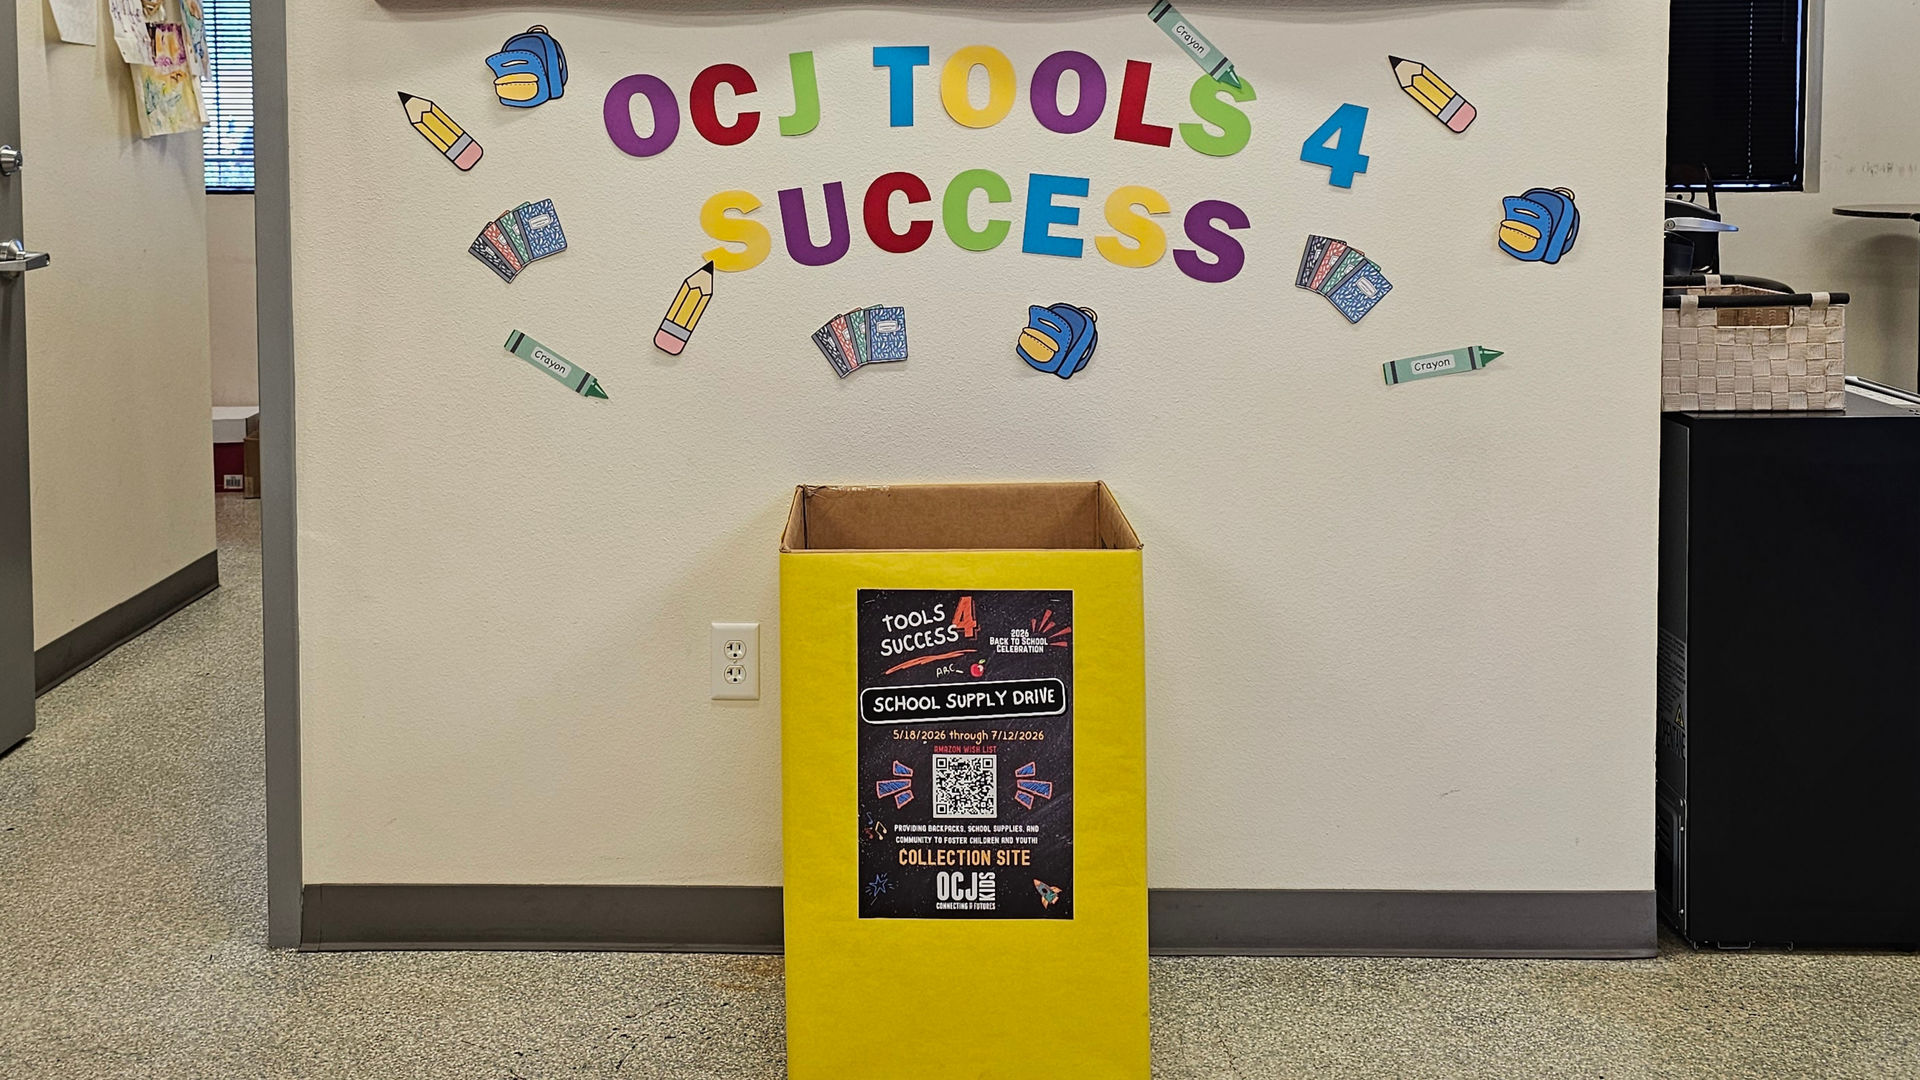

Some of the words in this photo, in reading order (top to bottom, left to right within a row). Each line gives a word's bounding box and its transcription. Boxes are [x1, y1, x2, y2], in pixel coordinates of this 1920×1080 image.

[1176, 25, 1205, 54] Crayon
[604, 52, 820, 157] OCJ
[873, 45, 1256, 157] TOOLS
[1300, 103, 1370, 189] 4
[700, 169, 1251, 283] SUCCESS
[534, 350, 566, 374] Crayon
[1414, 358, 1451, 372] Crayon
[882, 603, 946, 633] TOOLS
[951, 596, 979, 638] 4
[880, 624, 959, 657] SUCCESS
[1010, 629, 1030, 638] 2026
[873, 695, 941, 713] SCHOOL
[945, 690, 1007, 710] SUPPLY
[1012, 687, 1056, 706] DRIVE
[893, 729, 946, 740] 5/18/2026
[949, 730, 989, 746] through
[991, 730, 1045, 741] 7/12/2026
[933, 745, 962, 753] AMAZON
[963, 745, 981, 753] WISH
[982, 745, 997, 753] LIST
[894, 824, 927, 833] PROVIDING
[967, 825, 991, 833] SCHOOL
[1026, 825, 1040, 833] AND
[895, 836, 932, 844] COMMUNITY
[934, 836, 942, 844] TO
[944, 836, 968, 844] FOSTER
[969, 836, 1000, 845] CHILDREN
[1001, 836, 1014, 844] AND
[899, 848, 991, 866] COLLECTION
[996, 849, 1031, 866] SITE
[936, 871, 978, 901] OCJ
[978, 871, 996, 901] KIDS
[936, 902, 968, 910] CONNECTING
[973, 902, 996, 910] FUTURES
